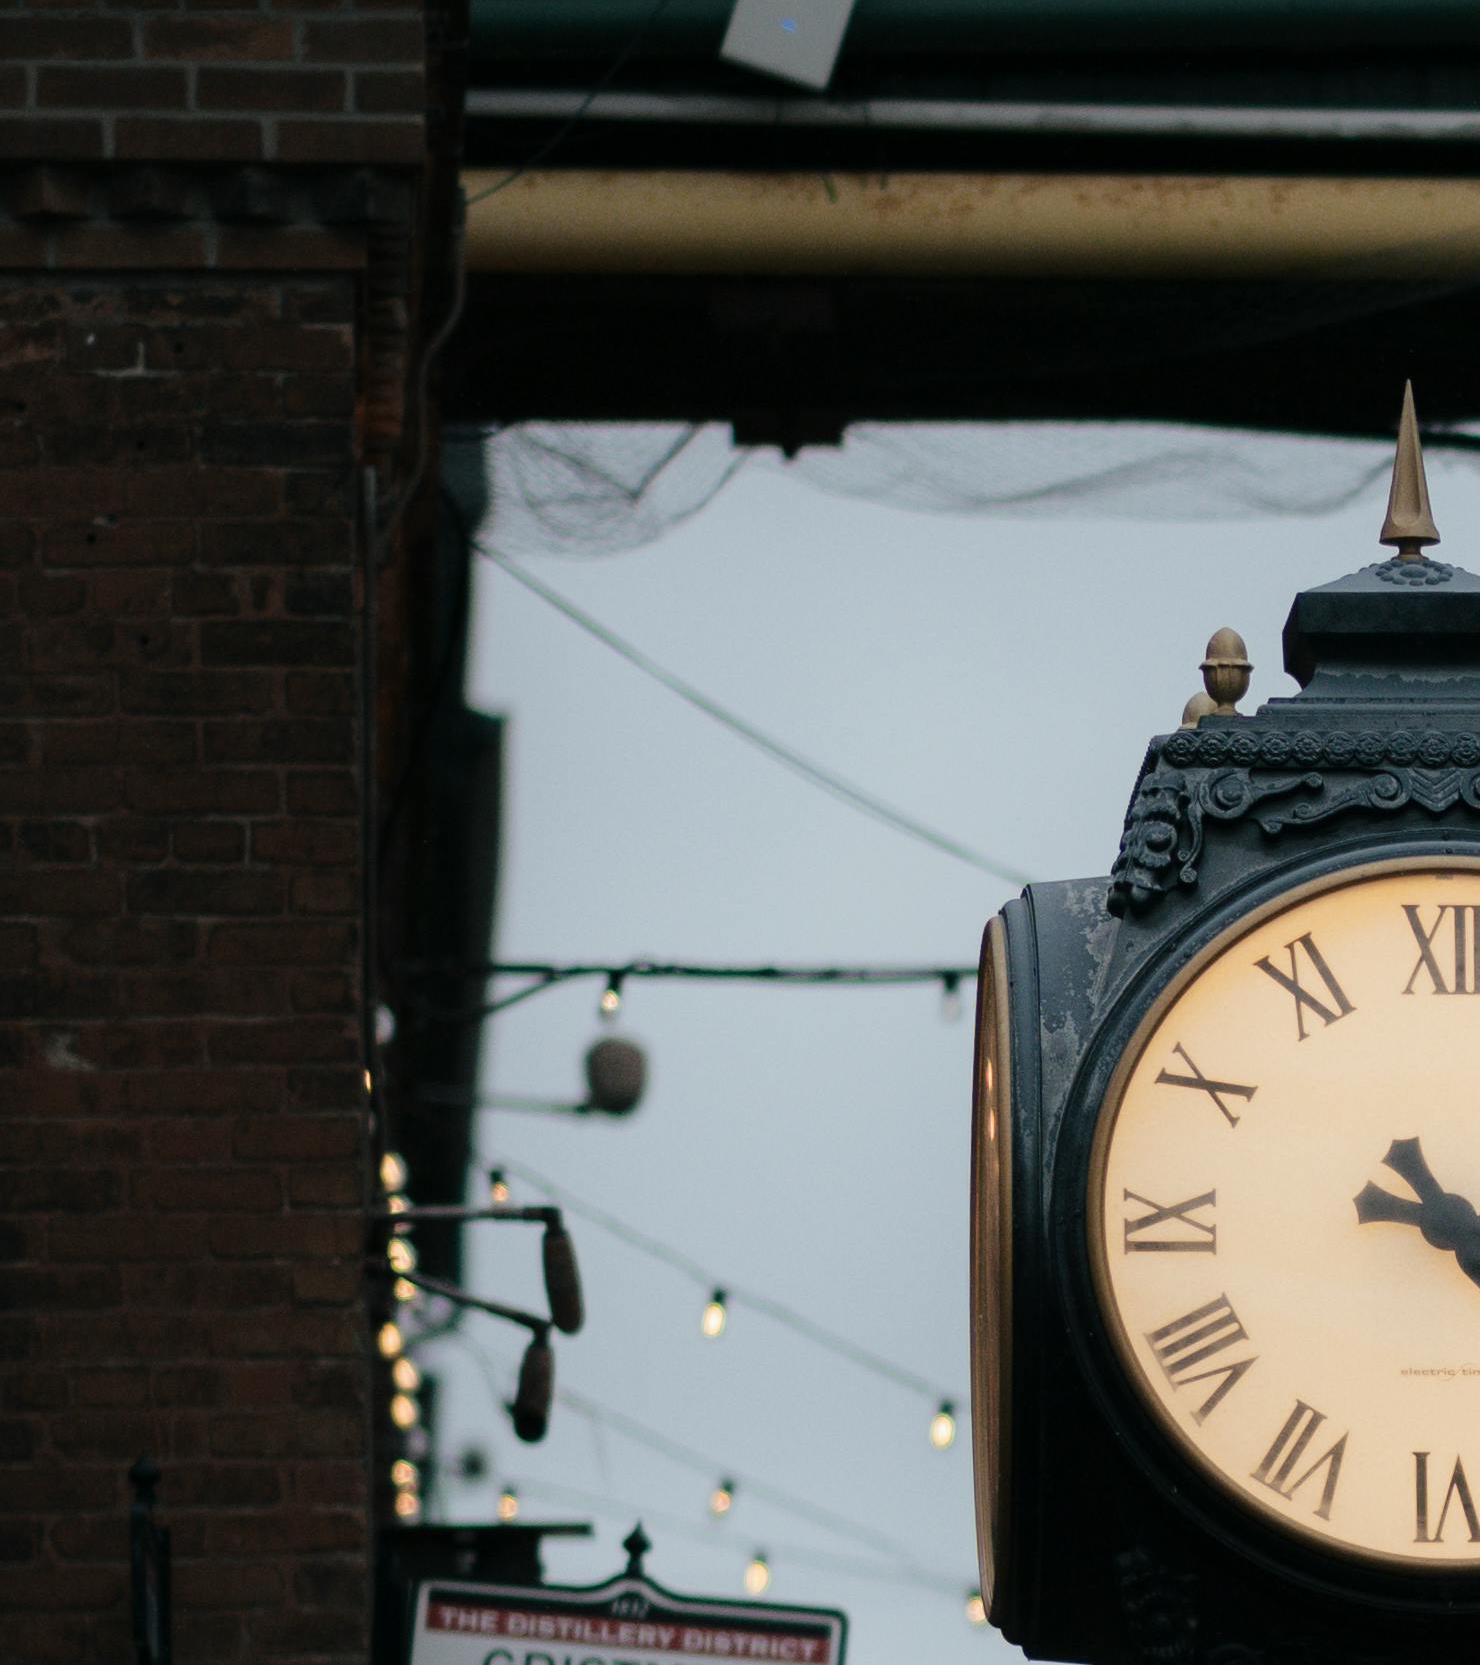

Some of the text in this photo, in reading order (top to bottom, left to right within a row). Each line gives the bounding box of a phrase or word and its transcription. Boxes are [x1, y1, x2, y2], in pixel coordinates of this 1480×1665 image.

[1253, 932, 1357, 1042] XI
[1155, 1041, 1258, 1128] X
[1124, 1188, 1217, 1255] IX
[1144, 1292, 1260, 1427] VIII
[1400, 1366, 1457, 1377] electric
[1250, 1398, 1350, 1521] VII
[438, 1604, 819, 1660] THE DISTILLERY DISTRICT
